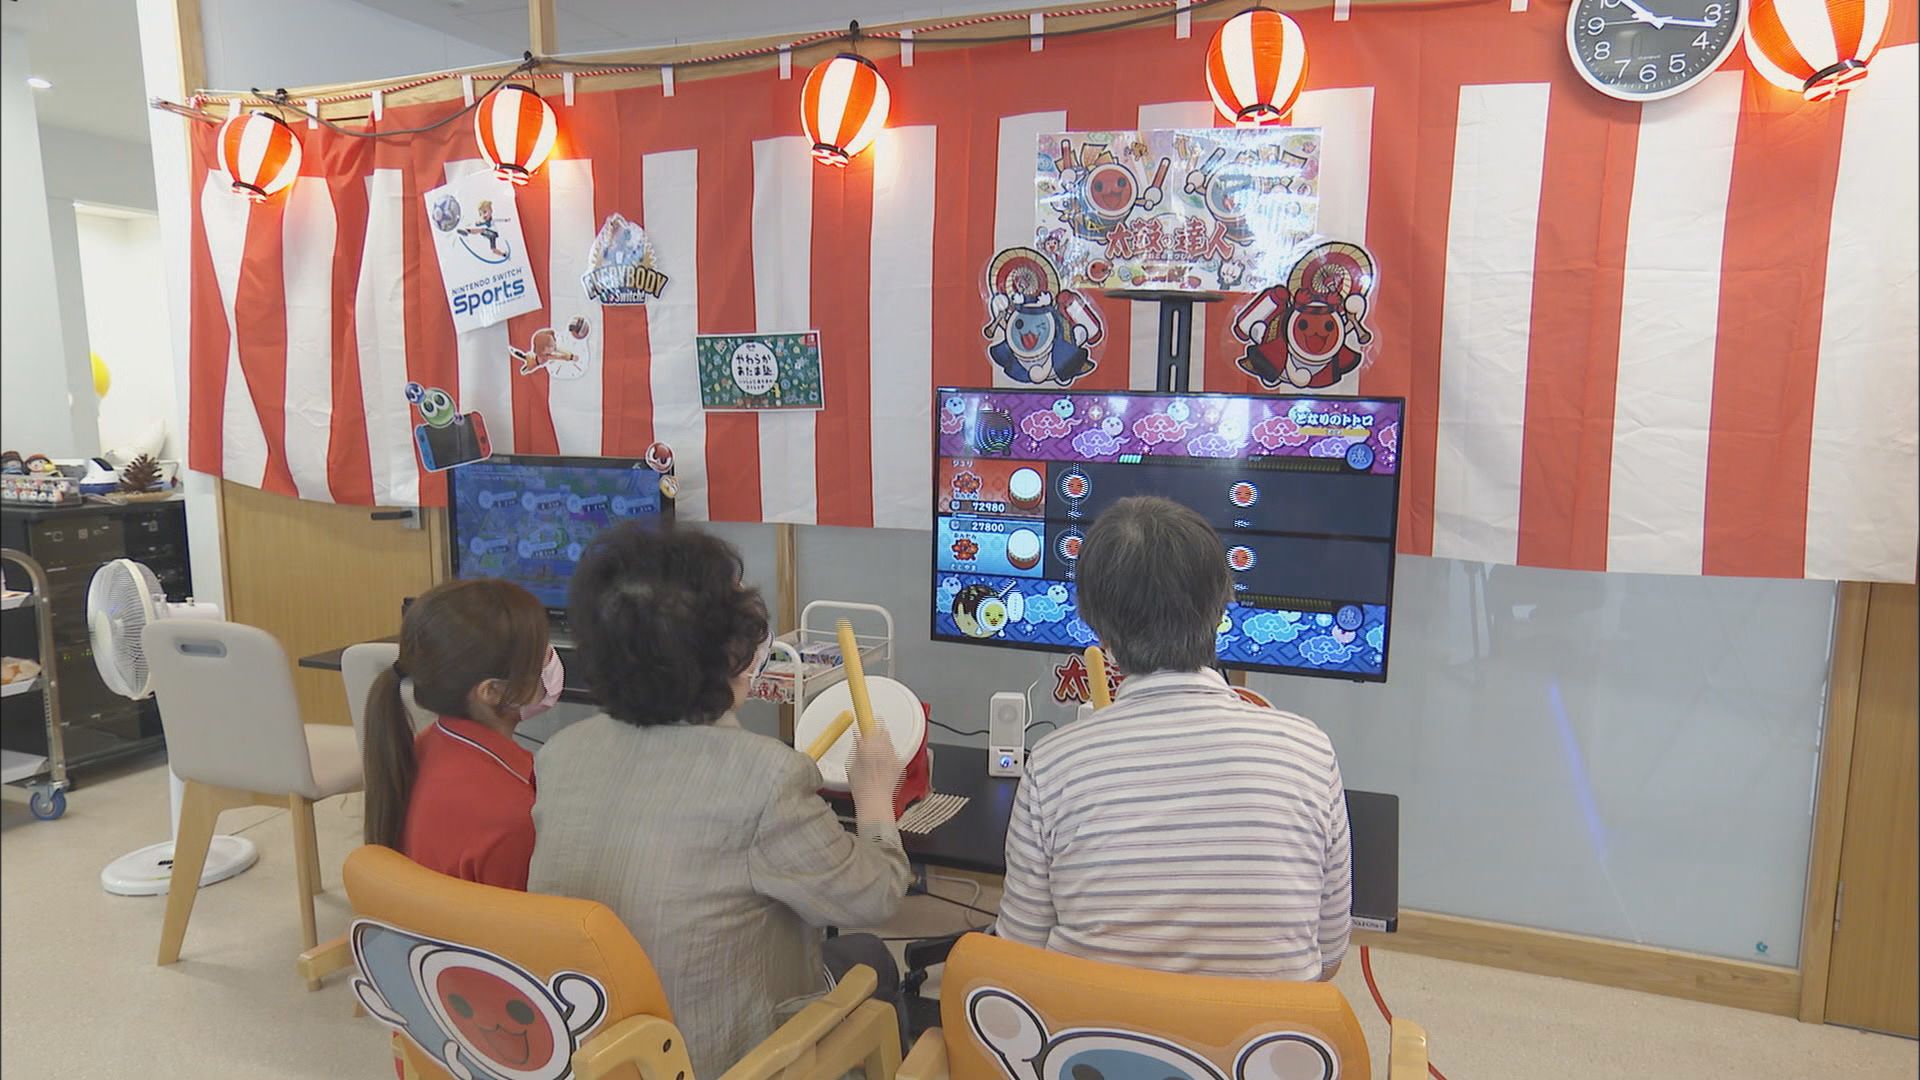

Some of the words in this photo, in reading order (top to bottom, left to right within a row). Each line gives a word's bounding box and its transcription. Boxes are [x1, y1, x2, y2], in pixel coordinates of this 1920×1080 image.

[1704, 4, 1722, 23] 3
[1587, 17, 1605, 35] 9
[1692, 31, 1710, 50] 4
[1594, 41, 1611, 60] 8
[1614, 59, 1631, 78] 7
[1639, 64, 1657, 82] 6
[1669, 54, 1686, 73] 5
[1105, 217, 1234, 260] 太鼓の達人
[452, 278, 490, 294] NINTENDO
[492, 268, 522, 282] SWITCH
[453, 279, 525, 315] Sports
[736, 354, 771, 365] やわらか
[1296, 412, 1373, 426] となりのトトロ
[972, 502, 1005, 512] 72980
[971, 522, 1004, 532] 27800
